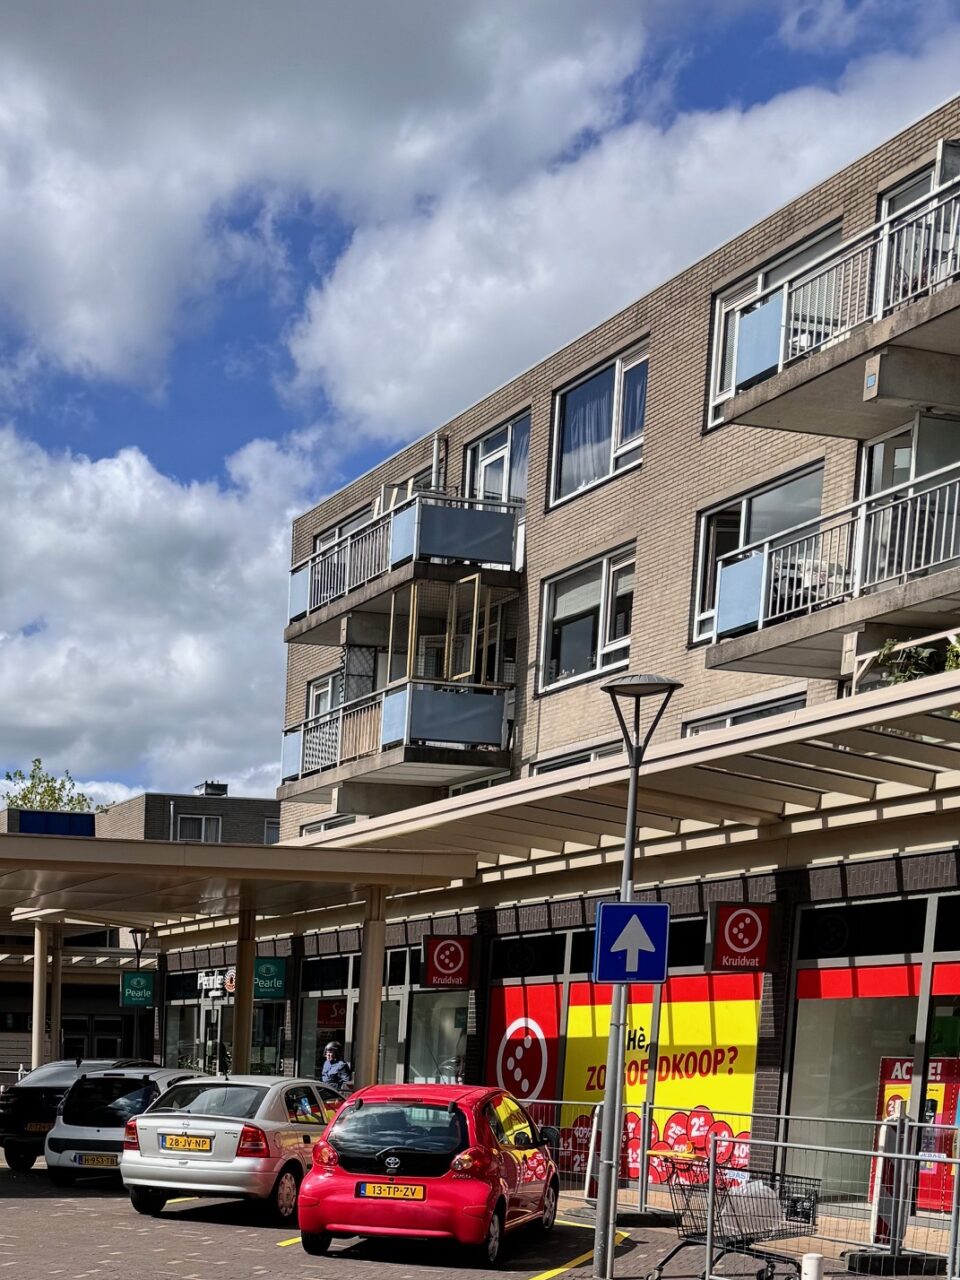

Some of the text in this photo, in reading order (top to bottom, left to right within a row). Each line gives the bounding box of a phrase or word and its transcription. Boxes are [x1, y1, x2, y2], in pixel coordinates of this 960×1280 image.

[722, 955, 759, 967] Kruidvat
[197, 970, 224, 989] Pearle
[253, 977, 283, 988] Pearle
[432, 976, 463, 985] Kruidvat
[125, 988, 152, 998] Pearle
[626, 1028, 650, 1053] Hè,
[585, 1046, 739, 1091] ZO OEDKOOP?
[891, 1061, 942, 1081] ACE!
[168, 1138, 207, 1149] 28-JV-NP
[83, 1156, 115, 1166] H-953-TB
[372, 1185, 417, 1197] 13-TP-ZV
